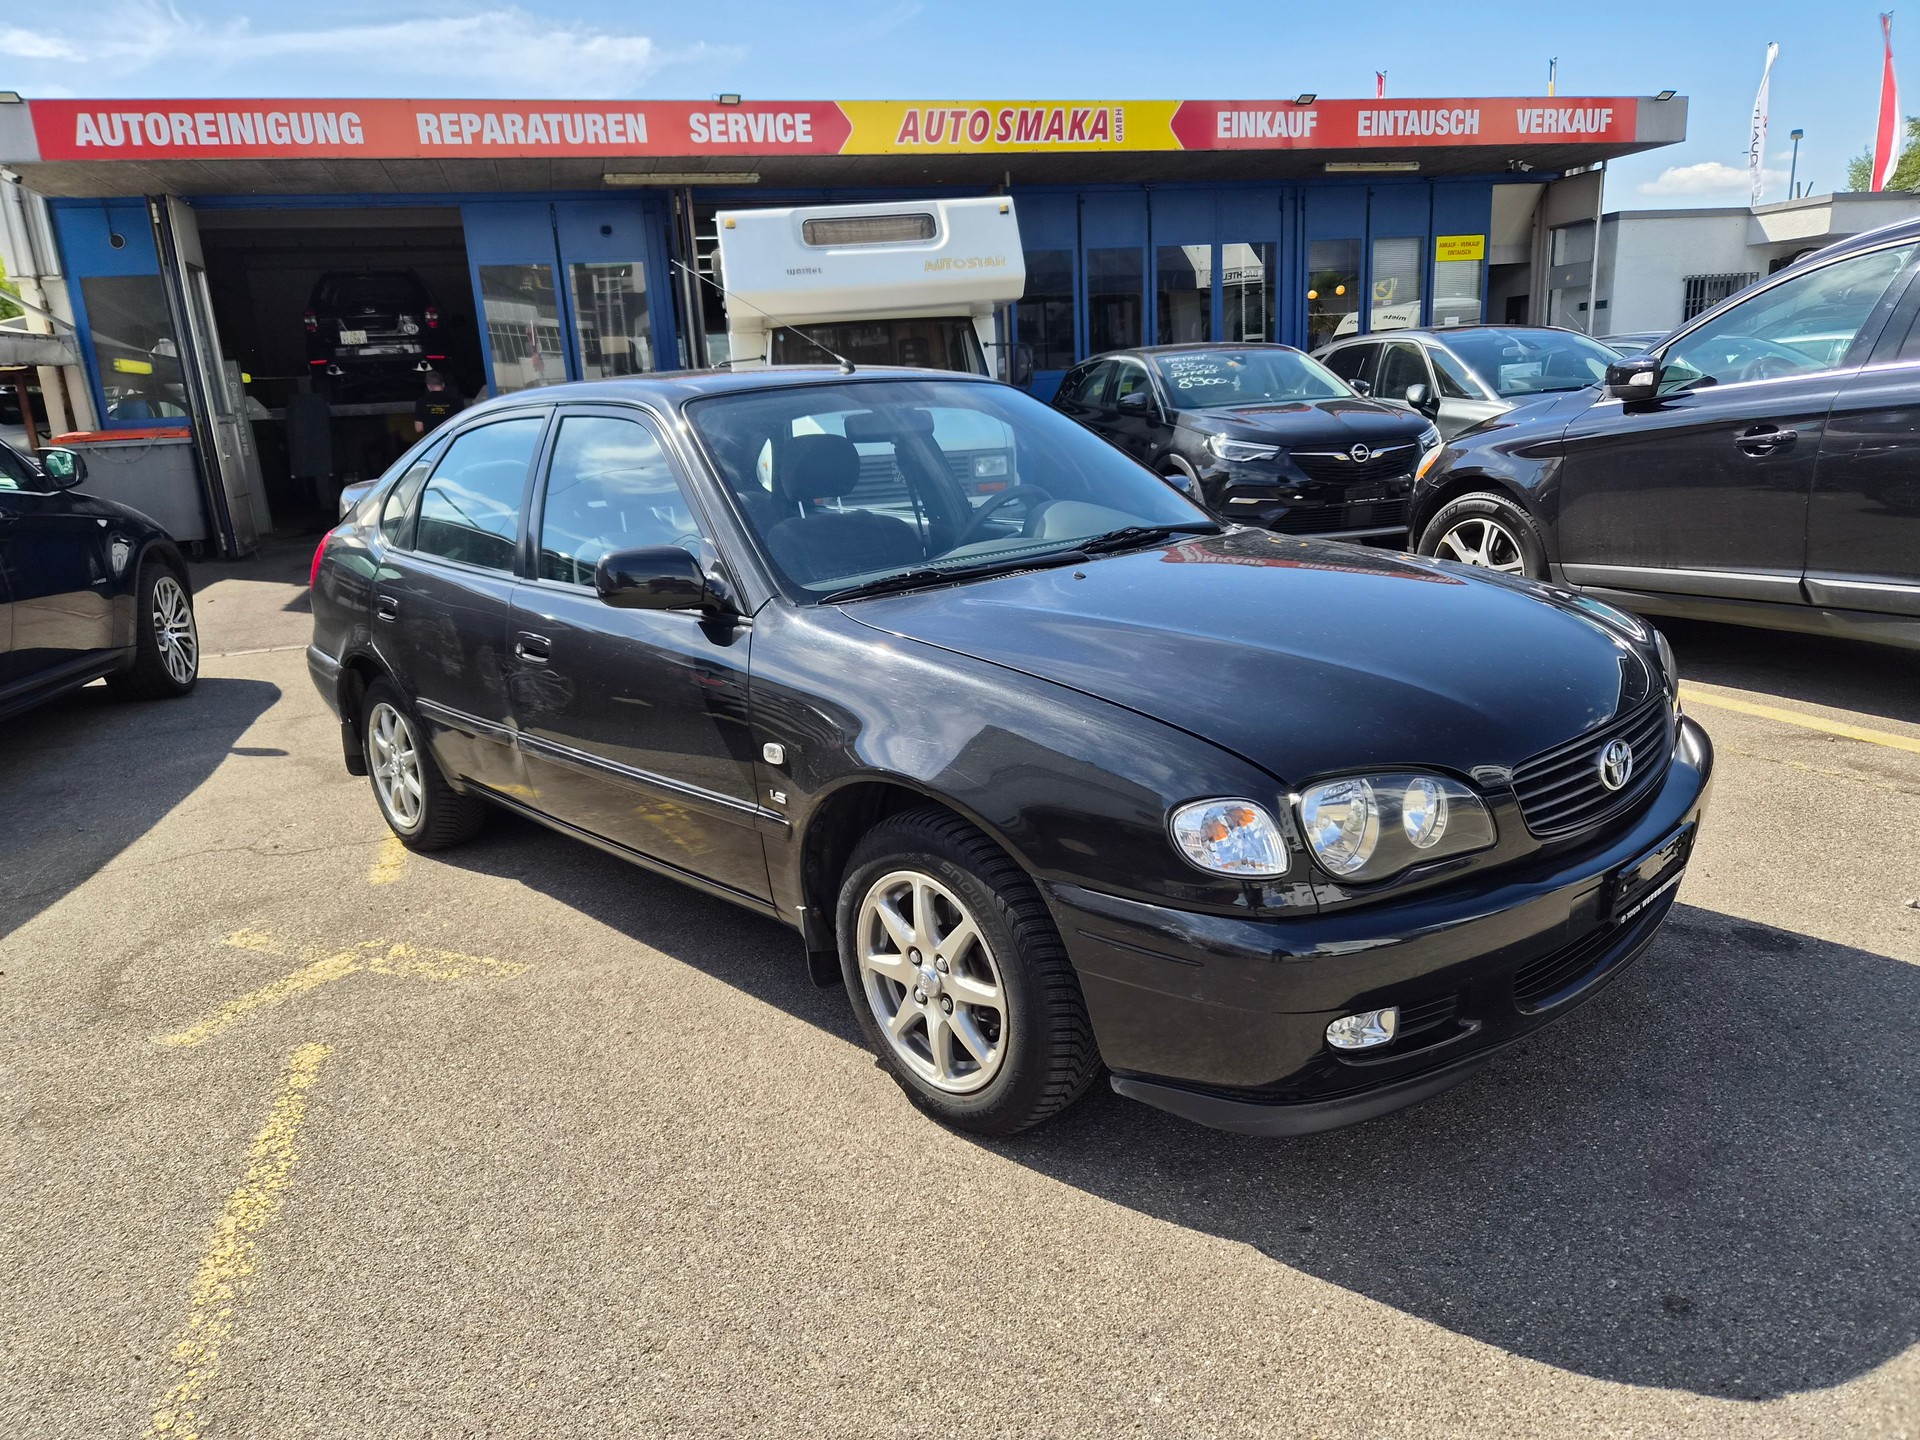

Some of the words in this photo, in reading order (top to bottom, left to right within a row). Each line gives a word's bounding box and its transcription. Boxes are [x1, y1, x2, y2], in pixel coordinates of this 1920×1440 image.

[75, 112, 365, 147] AUTOREINIGUNG
[416, 111, 648, 145] REPARATUREN
[689, 111, 813, 144] SERVICE
[1114, 108, 1124, 142] GMBH
[1216, 110, 1318, 140] EINKAUF
[1357, 108, 1481, 137] EINTAUSCH
[1516, 107, 1614, 135] VERKAUF
[924, 256, 1007, 273] AUTOSTAR
